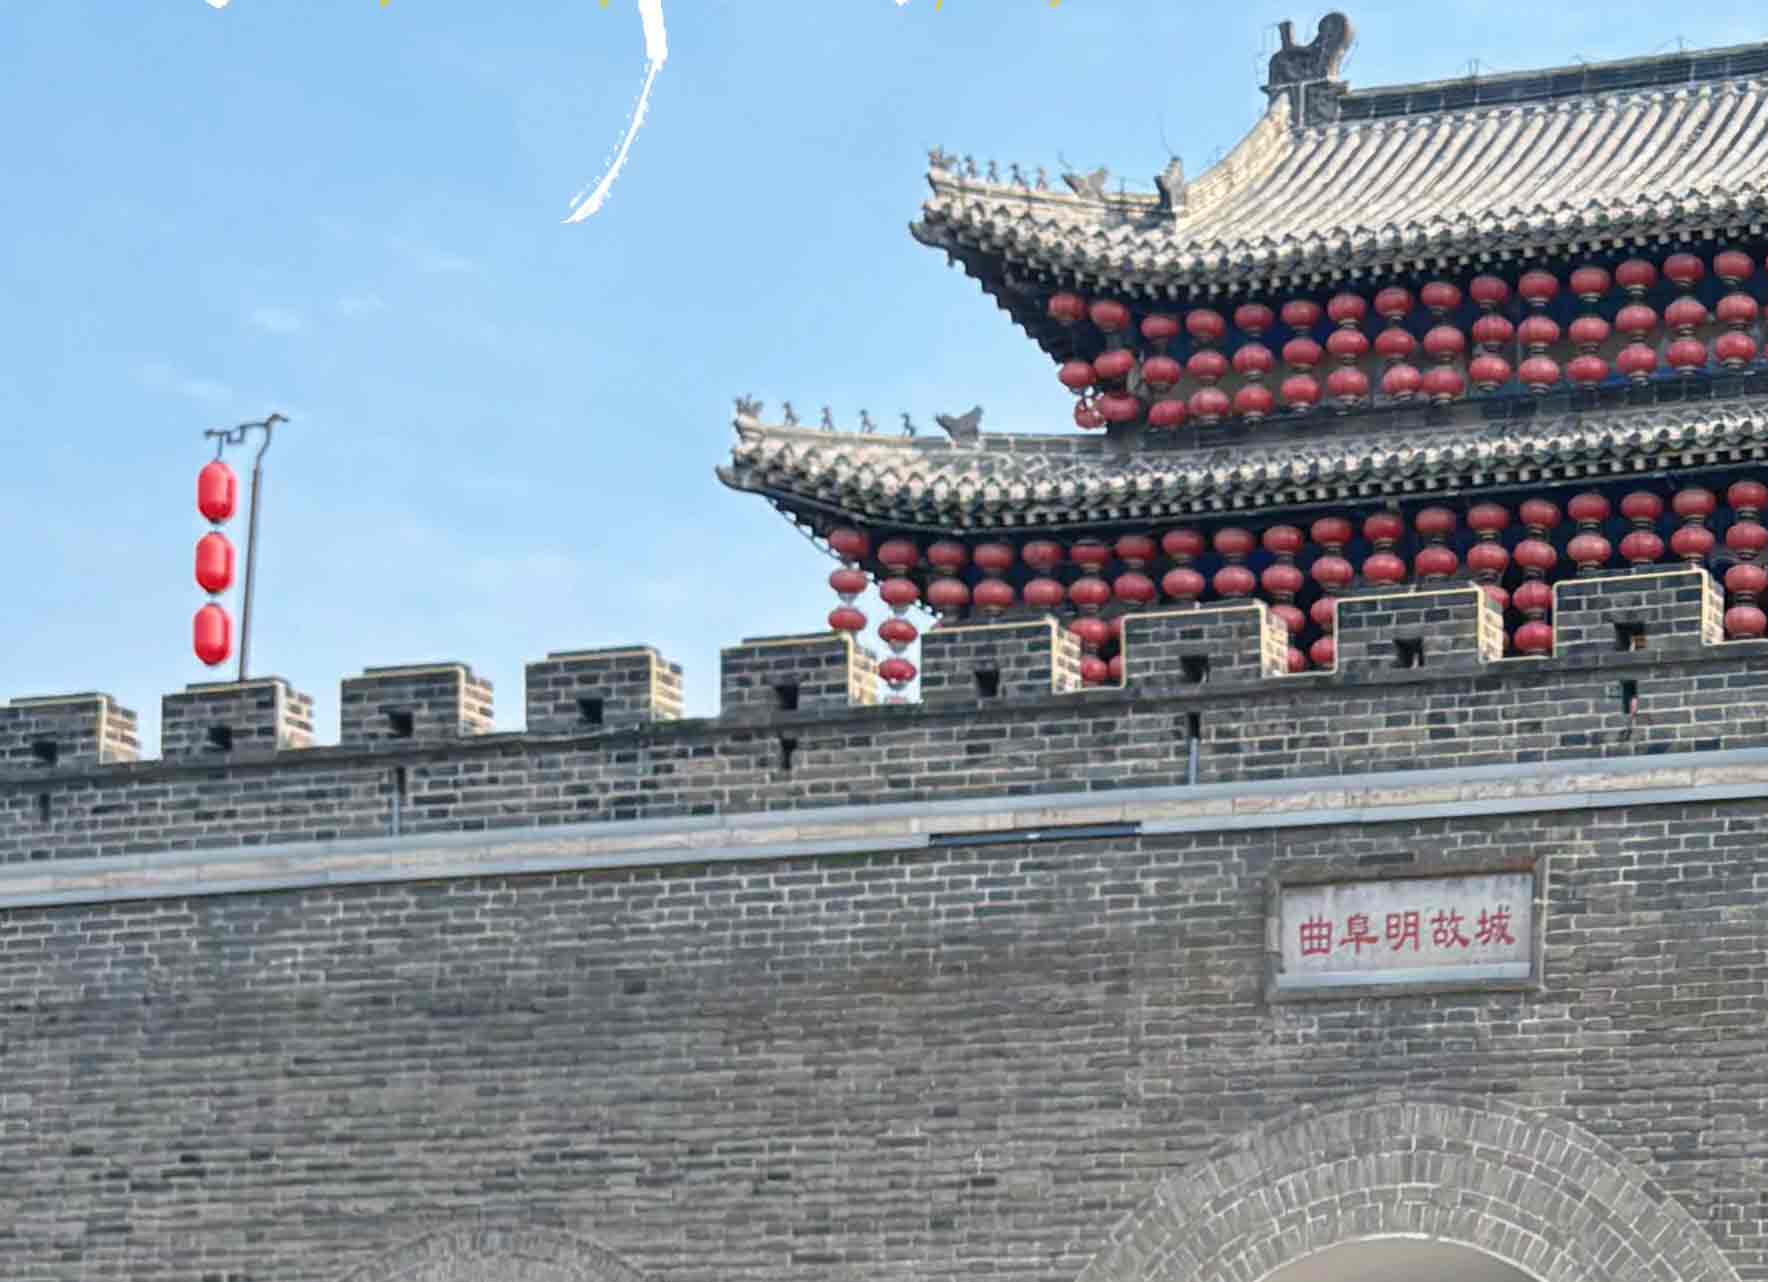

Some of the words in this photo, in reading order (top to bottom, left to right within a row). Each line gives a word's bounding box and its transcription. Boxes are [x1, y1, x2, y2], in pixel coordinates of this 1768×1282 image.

[1298, 904, 1516, 957] 曲阜明故城
